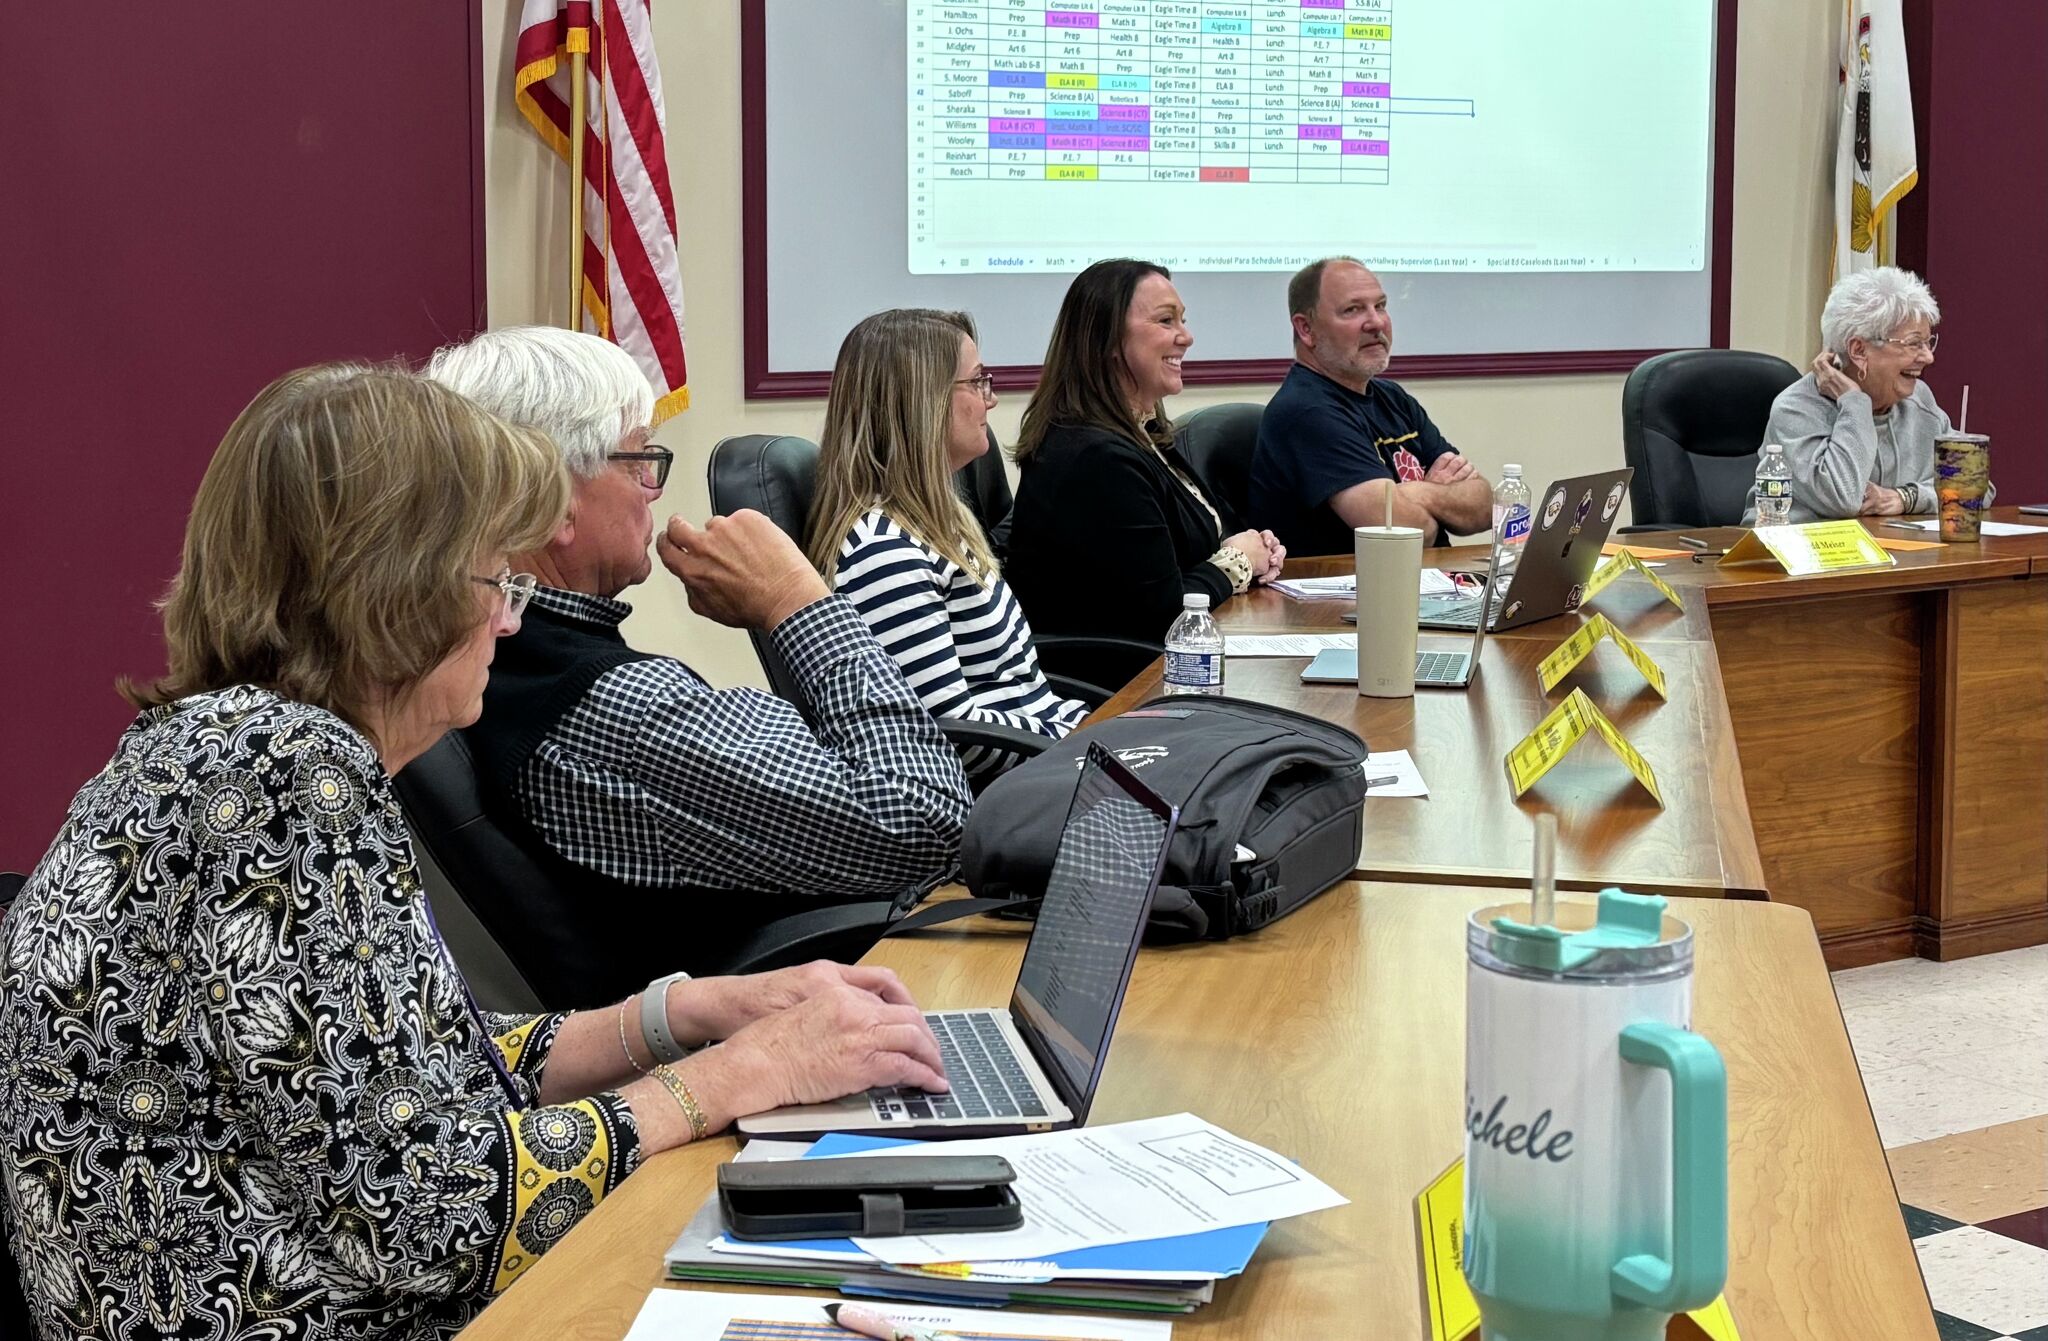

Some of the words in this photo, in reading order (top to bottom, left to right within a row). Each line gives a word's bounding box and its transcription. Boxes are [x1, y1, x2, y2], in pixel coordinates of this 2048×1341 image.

[1155, 4, 1173, 14] Eagle
[1175, 5, 1191, 14] Time
[1266, 9, 1286, 18] Lunch
[1009, 13, 1025, 23] Prep
[1112, 18, 1130, 26] Math
[1155, 20, 1173, 29] Eagle
[1174, 20, 1190, 29] Time
[1211, 22, 1236, 32] Algebra
[1008, 28, 1019, 37] P.E.
[1307, 26, 1331, 36] Algebra
[1064, 31, 1080, 41] Prep
[1110, 33, 1133, 42] Health
[1155, 35, 1173, 45] Eagle
[1174, 35, 1190, 44] Time
[1213, 37, 1234, 45] Health
[1266, 39, 1285, 47] Lunch
[1008, 45, 1020, 53] Art
[1063, 47, 1075, 55] Art
[1168, 50, 1183, 60] Prep
[1266, 54, 1285, 62] Lunch
[1313, 55, 1324, 64] Art
[994, 59, 1013, 68] Math
[1015, 60, 1028, 69] Lab
[1029, 61, 1040, 69] 6-8
[1060, 62, 1079, 70] Math
[1116, 64, 1132, 73] Prep
[1155, 65, 1172, 74] Eagle
[1174, 66, 1190, 74] Time
[1309, 70, 1326, 78] Math
[1155, 80, 1172, 90] Eagle
[1174, 81, 1190, 89] Time
[1216, 82, 1228, 90] ELA
[1265, 83, 1284, 91] Lunch
[1313, 85, 1329, 94] Prep
[1009, 91, 1026, 100] Prep
[1050, 92, 1076, 101] Science
[1154, 95, 1172, 104] Eagle
[1174, 96, 1190, 104] Time
[1265, 98, 1284, 106] Lunch
[1301, 99, 1324, 107] Science
[1351, 100, 1374, 109] Science
[1003, 107, 1026, 115] Science
[1154, 110, 1172, 120] Eagle
[1174, 110, 1190, 119] Time
[1218, 112, 1233, 120] Prep
[1265, 113, 1284, 121] Lunch
[1154, 125, 1172, 135] Eagle
[1173, 125, 1190, 134] Time
[1214, 126, 1230, 135] Skills
[1265, 127, 1284, 136] Lunch
[1358, 129, 1373, 138] Prep
[1154, 140, 1172, 150] Eagle
[1173, 140, 1189, 149] Time
[1214, 141, 1230, 149] Skills
[1264, 142, 1284, 150] Lunch
[1312, 143, 1327, 152] Prep
[1008, 152, 1020, 161] P.E.
[1063, 153, 1074, 162] P.E.
[1115, 154, 1126, 163] P.E.
[1009, 168, 1026, 177] Prep
[1154, 170, 1172, 180] Eagle
[1173, 170, 1189, 178] Time
[988, 258, 1024, 266] Schedule
[1511, 520, 1530, 536] pro
[1466, 1095, 1574, 1162] ichele
